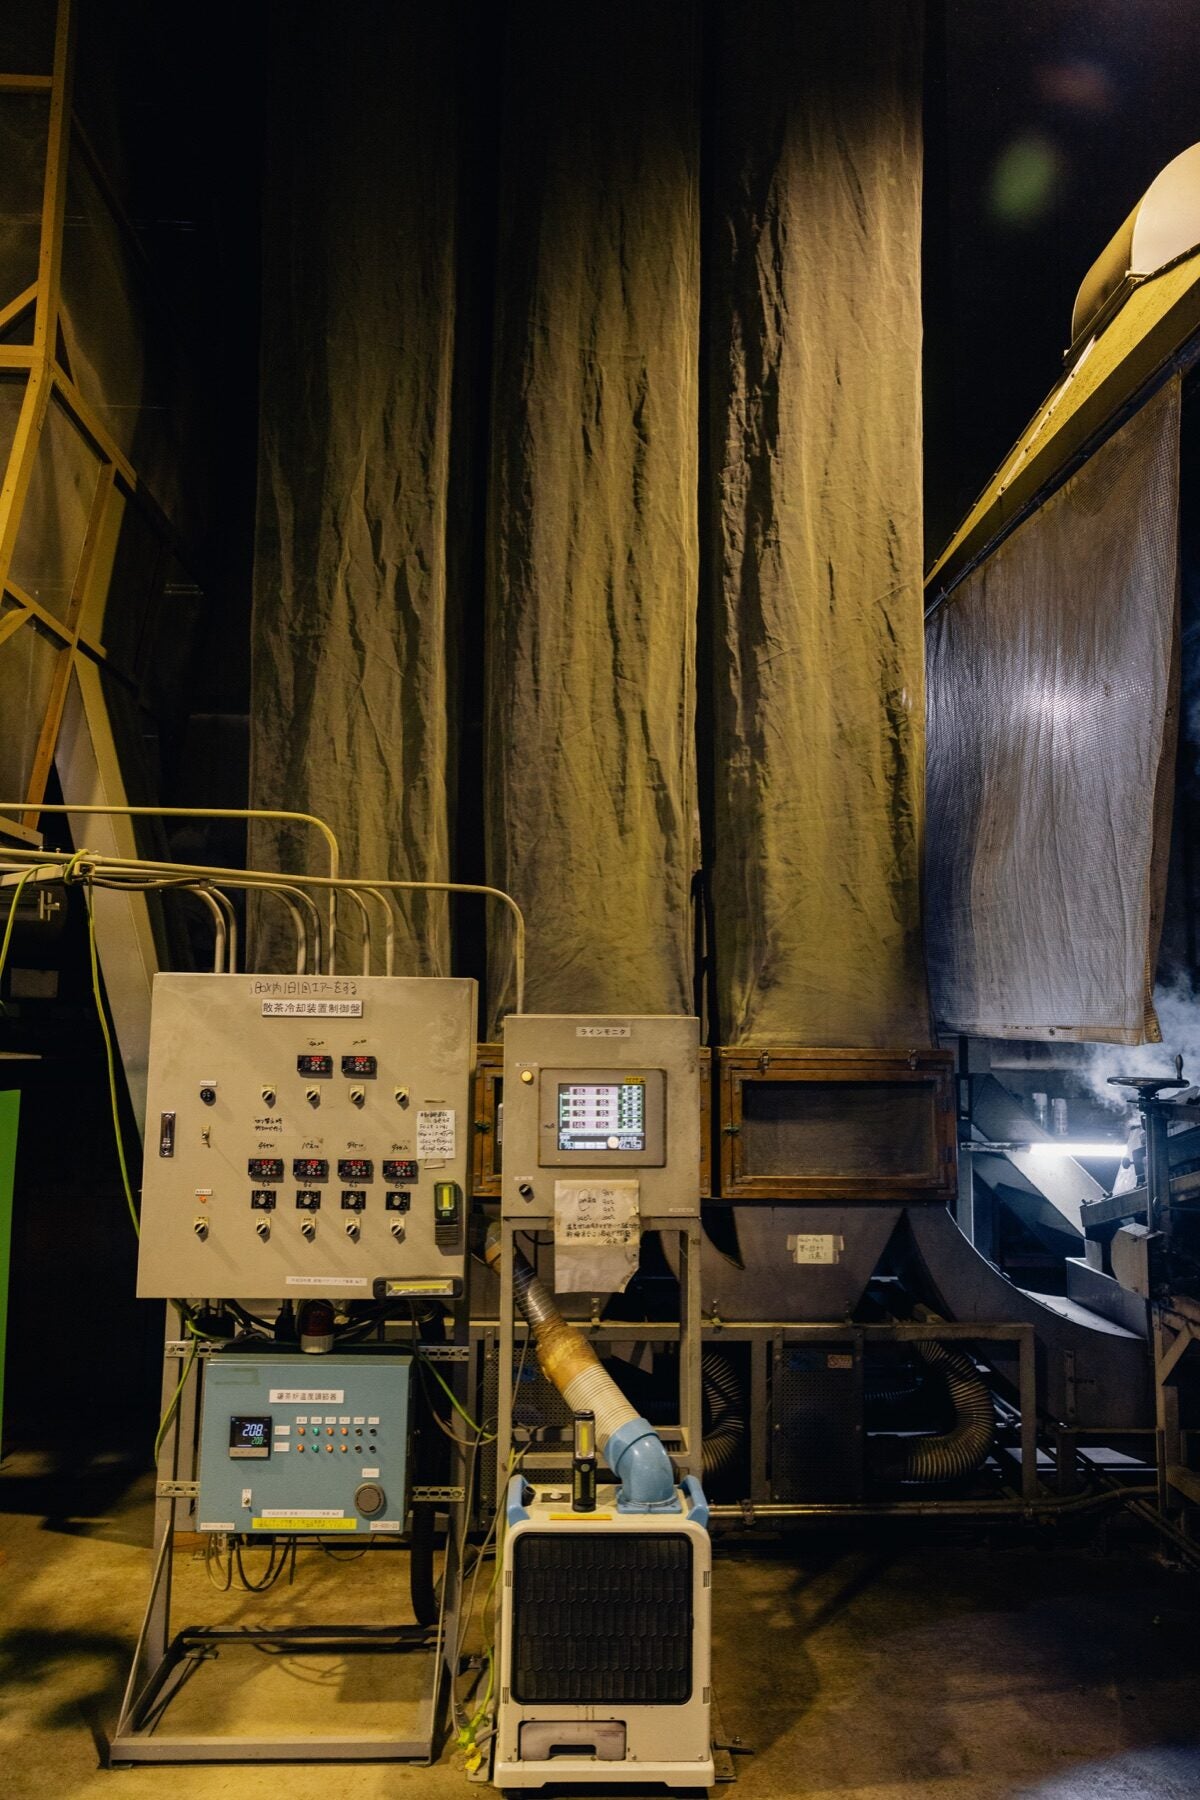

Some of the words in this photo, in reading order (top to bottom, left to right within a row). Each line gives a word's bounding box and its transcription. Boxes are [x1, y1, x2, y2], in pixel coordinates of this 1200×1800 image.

[263, 1002, 361, 1015] 散茶冷却装置制御盤
[581, 1028, 626, 1036] ラインモニタ
[242, 1423, 264, 1437] 208
